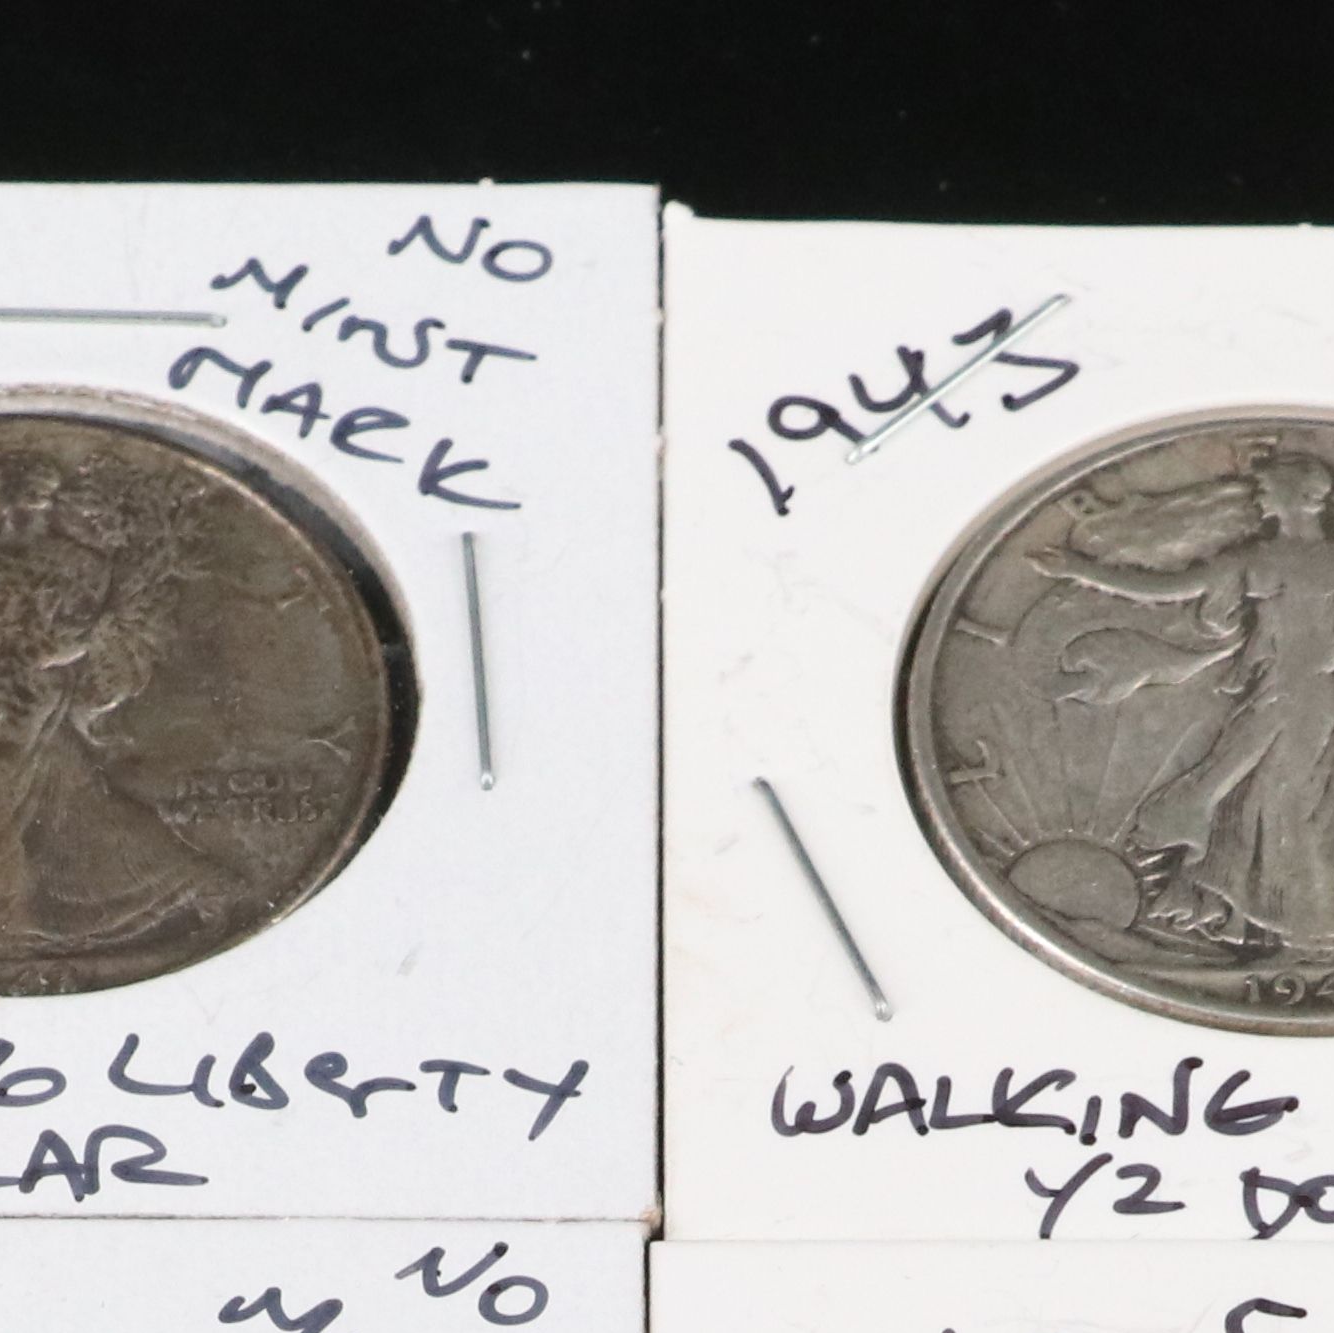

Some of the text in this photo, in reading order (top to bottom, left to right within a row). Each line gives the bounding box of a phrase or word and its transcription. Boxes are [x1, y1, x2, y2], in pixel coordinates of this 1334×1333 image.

[388, 215, 553, 282] NO
[211, 258, 538, 385] MINT
[168, 346, 521, 510] MARK
[728, 308, 1080, 518] 1943
[770, 1058, 1300, 1147] WALKING
[396, 1241, 549, 1327] NO
